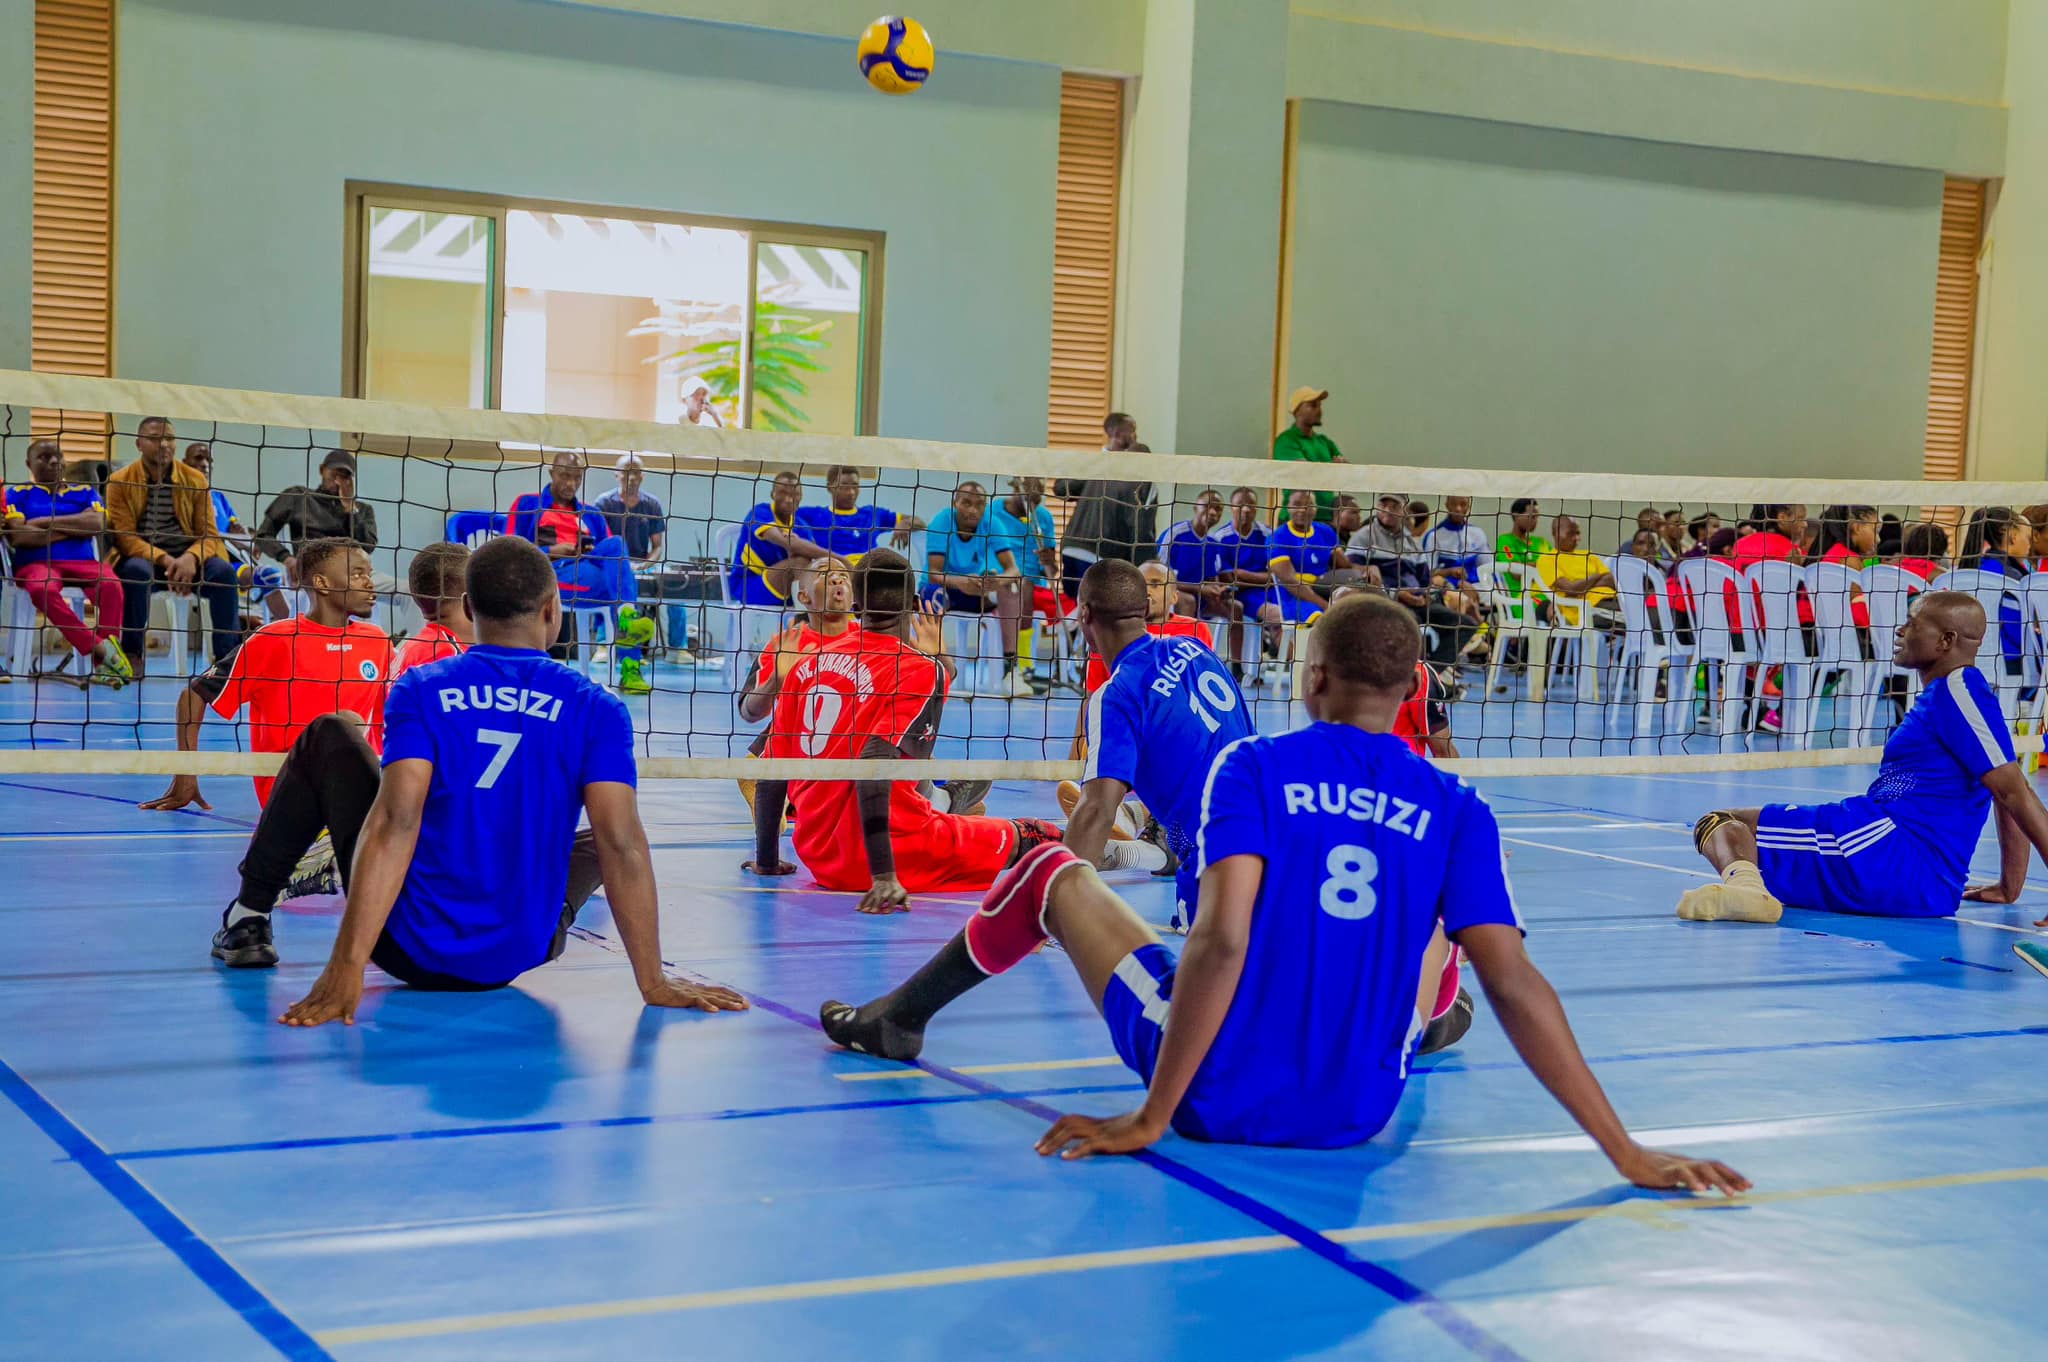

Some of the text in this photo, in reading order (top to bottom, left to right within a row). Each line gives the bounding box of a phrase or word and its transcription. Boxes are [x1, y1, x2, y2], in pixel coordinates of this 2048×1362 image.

[1151, 641, 1203, 698] RUSIZI
[439, 685, 563, 722] RUSIZI
[800, 684, 842, 756] 9
[1189, 670, 1236, 734] 10
[475, 728, 523, 789] 7
[1283, 782, 1431, 841] RUSIZI
[1319, 844, 1379, 920] 8
